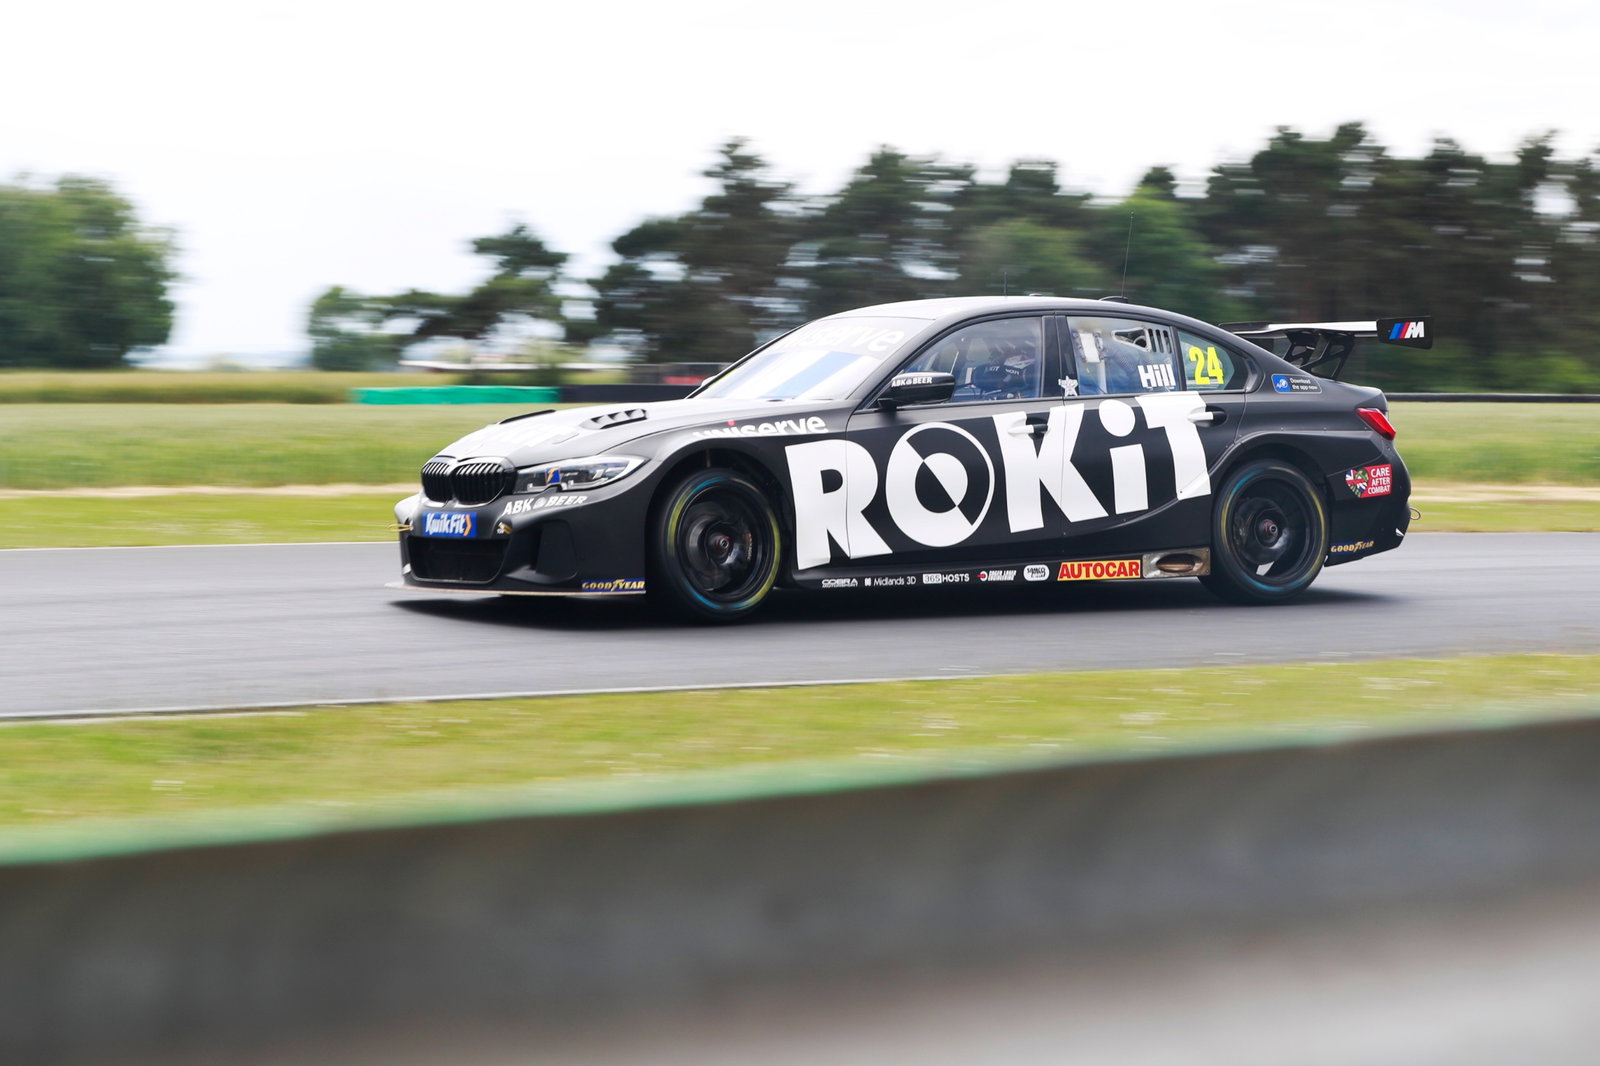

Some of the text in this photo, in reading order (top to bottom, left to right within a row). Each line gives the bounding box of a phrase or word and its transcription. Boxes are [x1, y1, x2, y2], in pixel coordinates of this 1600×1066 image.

[1188, 346, 1224, 385] 24
[1137, 363, 1176, 388] Hill
[891, 379, 906, 387] ABK
[1370, 467, 1390, 477] CARE
[1371, 477, 1390, 486] AFTER
[1367, 485, 1391, 494] COMBAT
[502, 496, 588, 515] ABK BEER
[1330, 541, 1374, 552] GOODYEAR
[1059, 561, 1140, 579] AUTOCAR
[582, 579, 645, 591] GOODYEAR
[822, 578, 858, 586] COBRA
[873, 576, 916, 586] Midlands 3D
